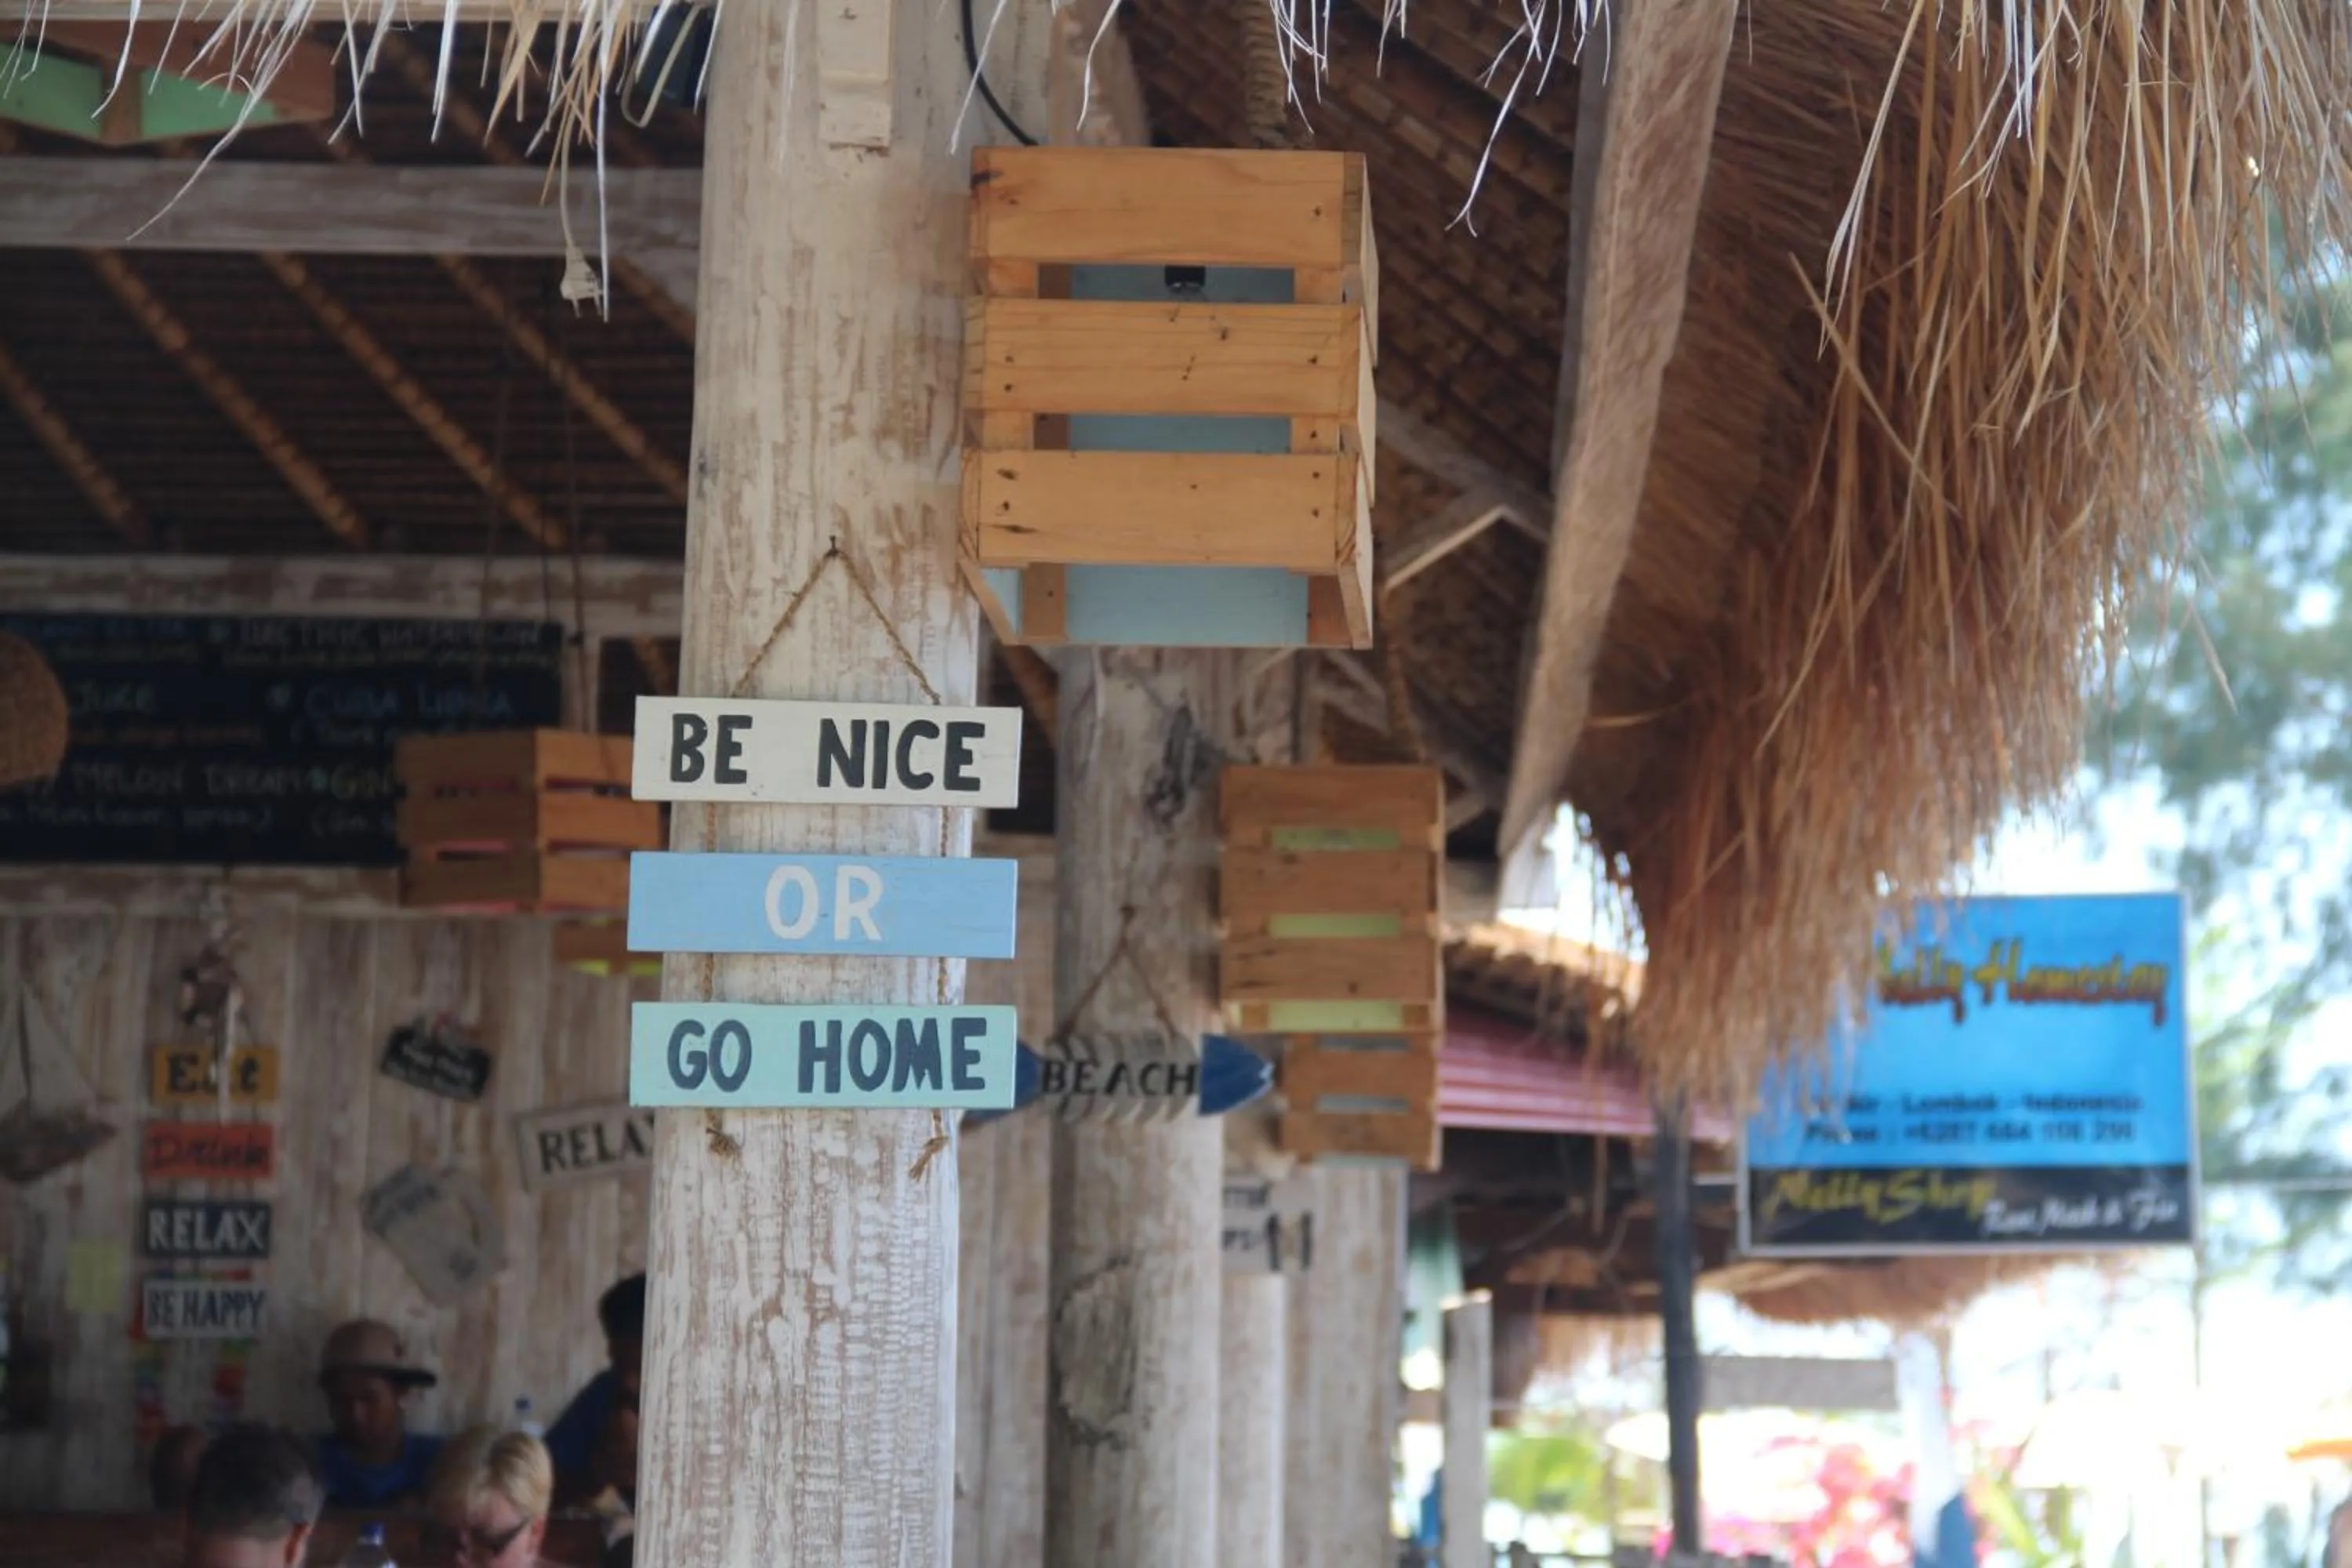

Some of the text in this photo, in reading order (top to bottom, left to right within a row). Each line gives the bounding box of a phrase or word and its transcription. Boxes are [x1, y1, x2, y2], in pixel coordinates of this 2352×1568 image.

[670, 713, 986, 793] BE NICE
[764, 864, 885, 942] OR
[666, 1017, 988, 1094] GO HOME
[1041, 1062, 1198, 1095] BEACH
[148, 1207, 267, 1252] RELAX
[147, 1288, 267, 1330] BE HAPPY
